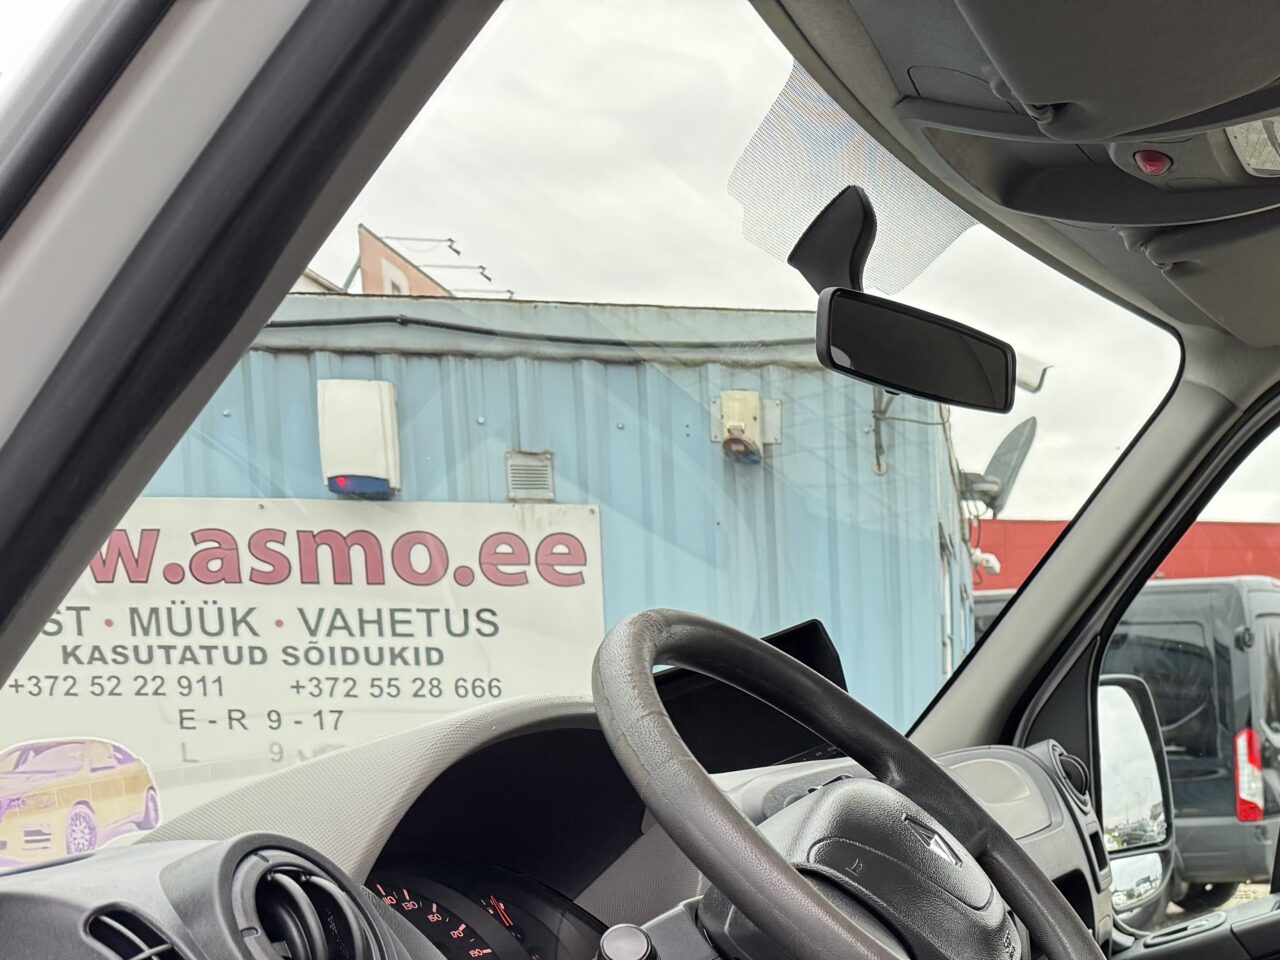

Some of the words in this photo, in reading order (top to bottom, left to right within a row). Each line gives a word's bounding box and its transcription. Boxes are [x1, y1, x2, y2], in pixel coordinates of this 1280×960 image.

[128, 600, 261, 637] MÜÜK
[297, 607, 500, 638] VAHETUS
[61, 644, 269, 666] KASUTATUD
[281, 641, 445, 667] SÕIDUKID
[8, 675, 79, 697] +372
[90, 675, 123, 697] 52
[132, 675, 166, 697] 22
[177, 675, 224, 698] 911
[290, 677, 359, 698] +372
[369, 677, 402, 698] 55
[411, 677, 444, 698] 28
[454, 677, 503, 698] 666
[402, 900, 418, 911] 130
